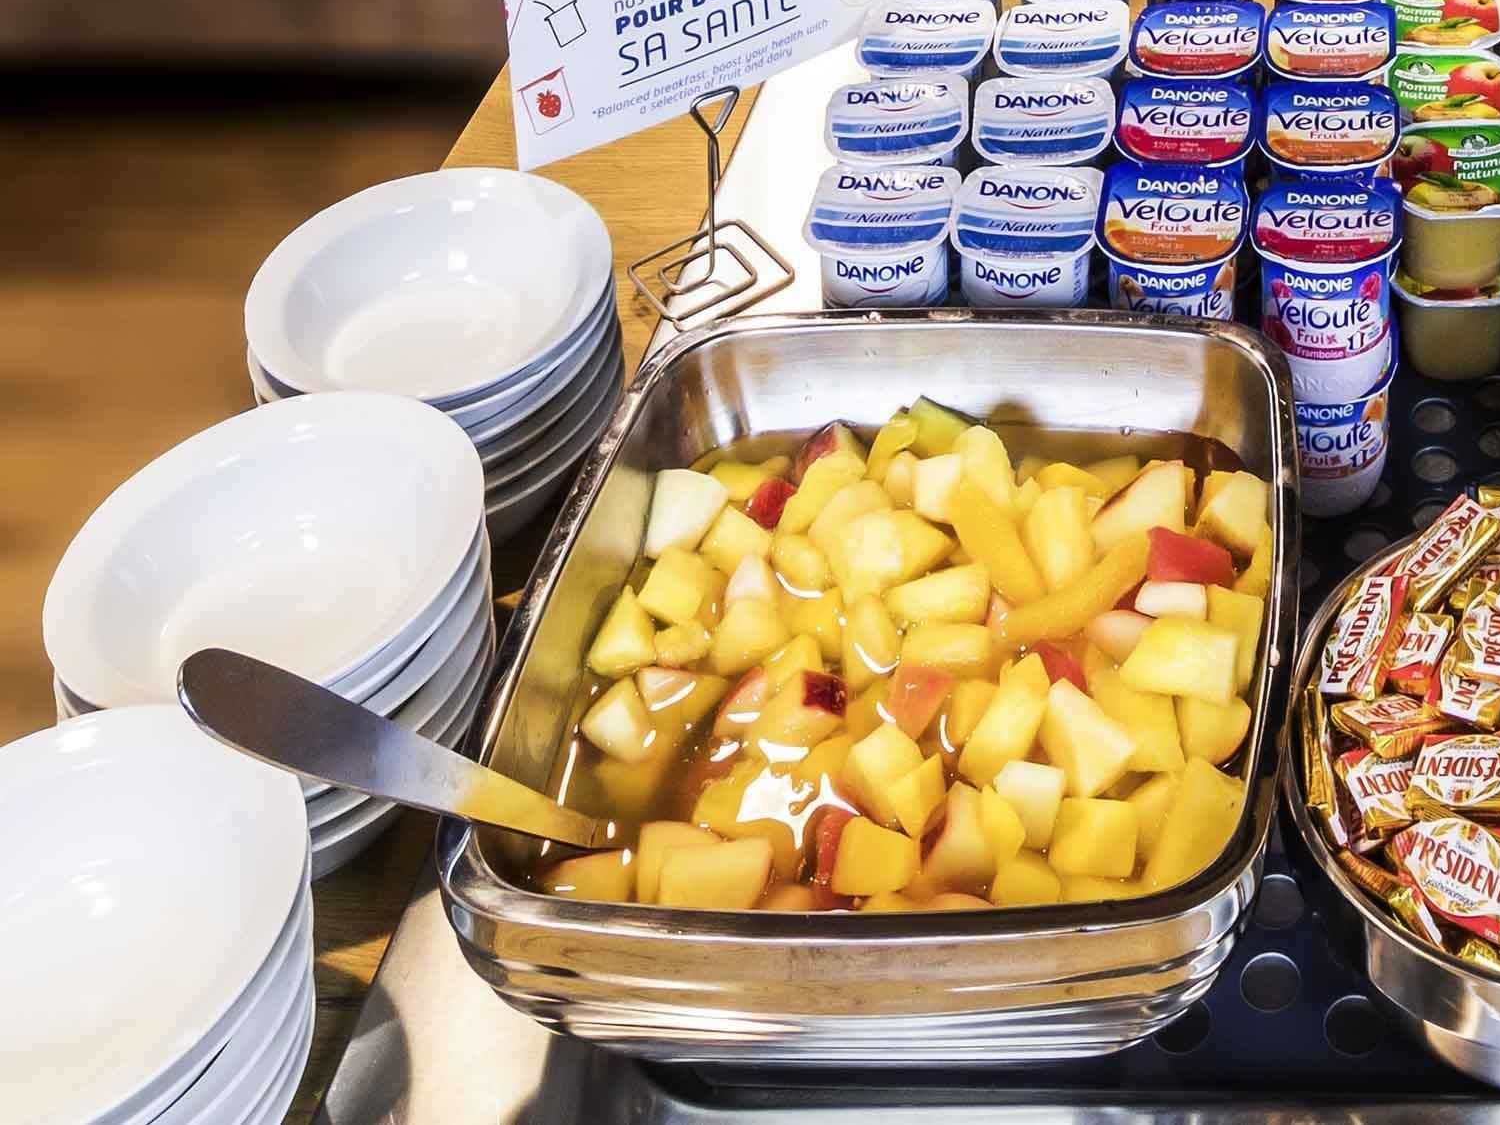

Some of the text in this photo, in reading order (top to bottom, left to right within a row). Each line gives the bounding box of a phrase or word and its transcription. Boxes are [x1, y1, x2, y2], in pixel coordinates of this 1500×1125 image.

[1395, 5, 1443, 16] Pomme
[1397, 14, 1440, 23] nature
[1146, 25, 1257, 45] Velouté
[1274, 25, 1386, 46] Velouté
[619, 32, 666, 75] SA
[713, 57, 742, 75] boost
[745, 45, 768, 62] your
[771, 29, 803, 48] health
[807, 19, 829, 35] with
[651, 85, 701, 110] selection
[704, 77, 715, 88] of
[719, 67, 742, 84] fruit
[745, 59, 763, 73] and
[767, 48, 793, 66] dairy
[1398, 80, 1448, 93] Pomme
[1400, 90, 1446, 101] nature
[1128, 101, 1248, 127] Velouté
[1272, 109, 1393, 131] Velouté
[1113, 193, 1240, 223] Velouté
[1266, 207, 1392, 230] Velouté
[1275, 296, 1372, 330] Velouté
[1297, 347, 1344, 359] Framboise
[1296, 402, 1354, 419] ANONE
[1297, 421, 1371, 453] elouté
[1327, 580, 1384, 683] PRÉSIDENT
